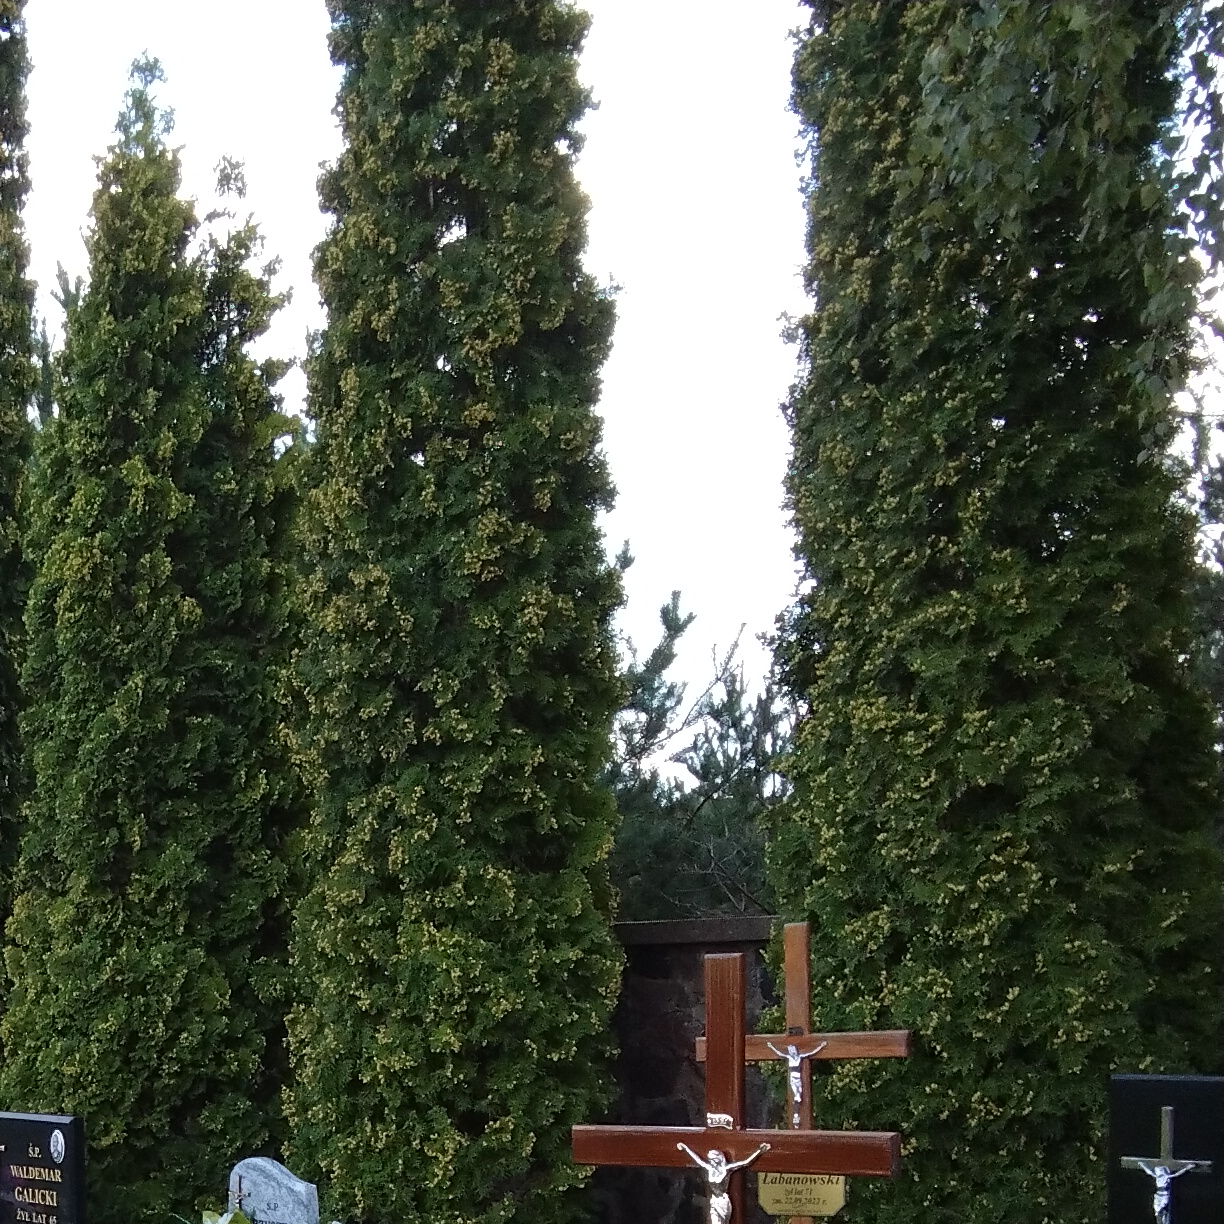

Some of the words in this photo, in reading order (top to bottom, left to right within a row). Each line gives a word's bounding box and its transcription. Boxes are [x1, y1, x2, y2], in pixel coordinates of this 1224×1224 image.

[10, 1165, 62, 1182] WALDEMAR
[15, 1186, 57, 1206] GALICKI
[32, 1212, 47, 1224] LAT
